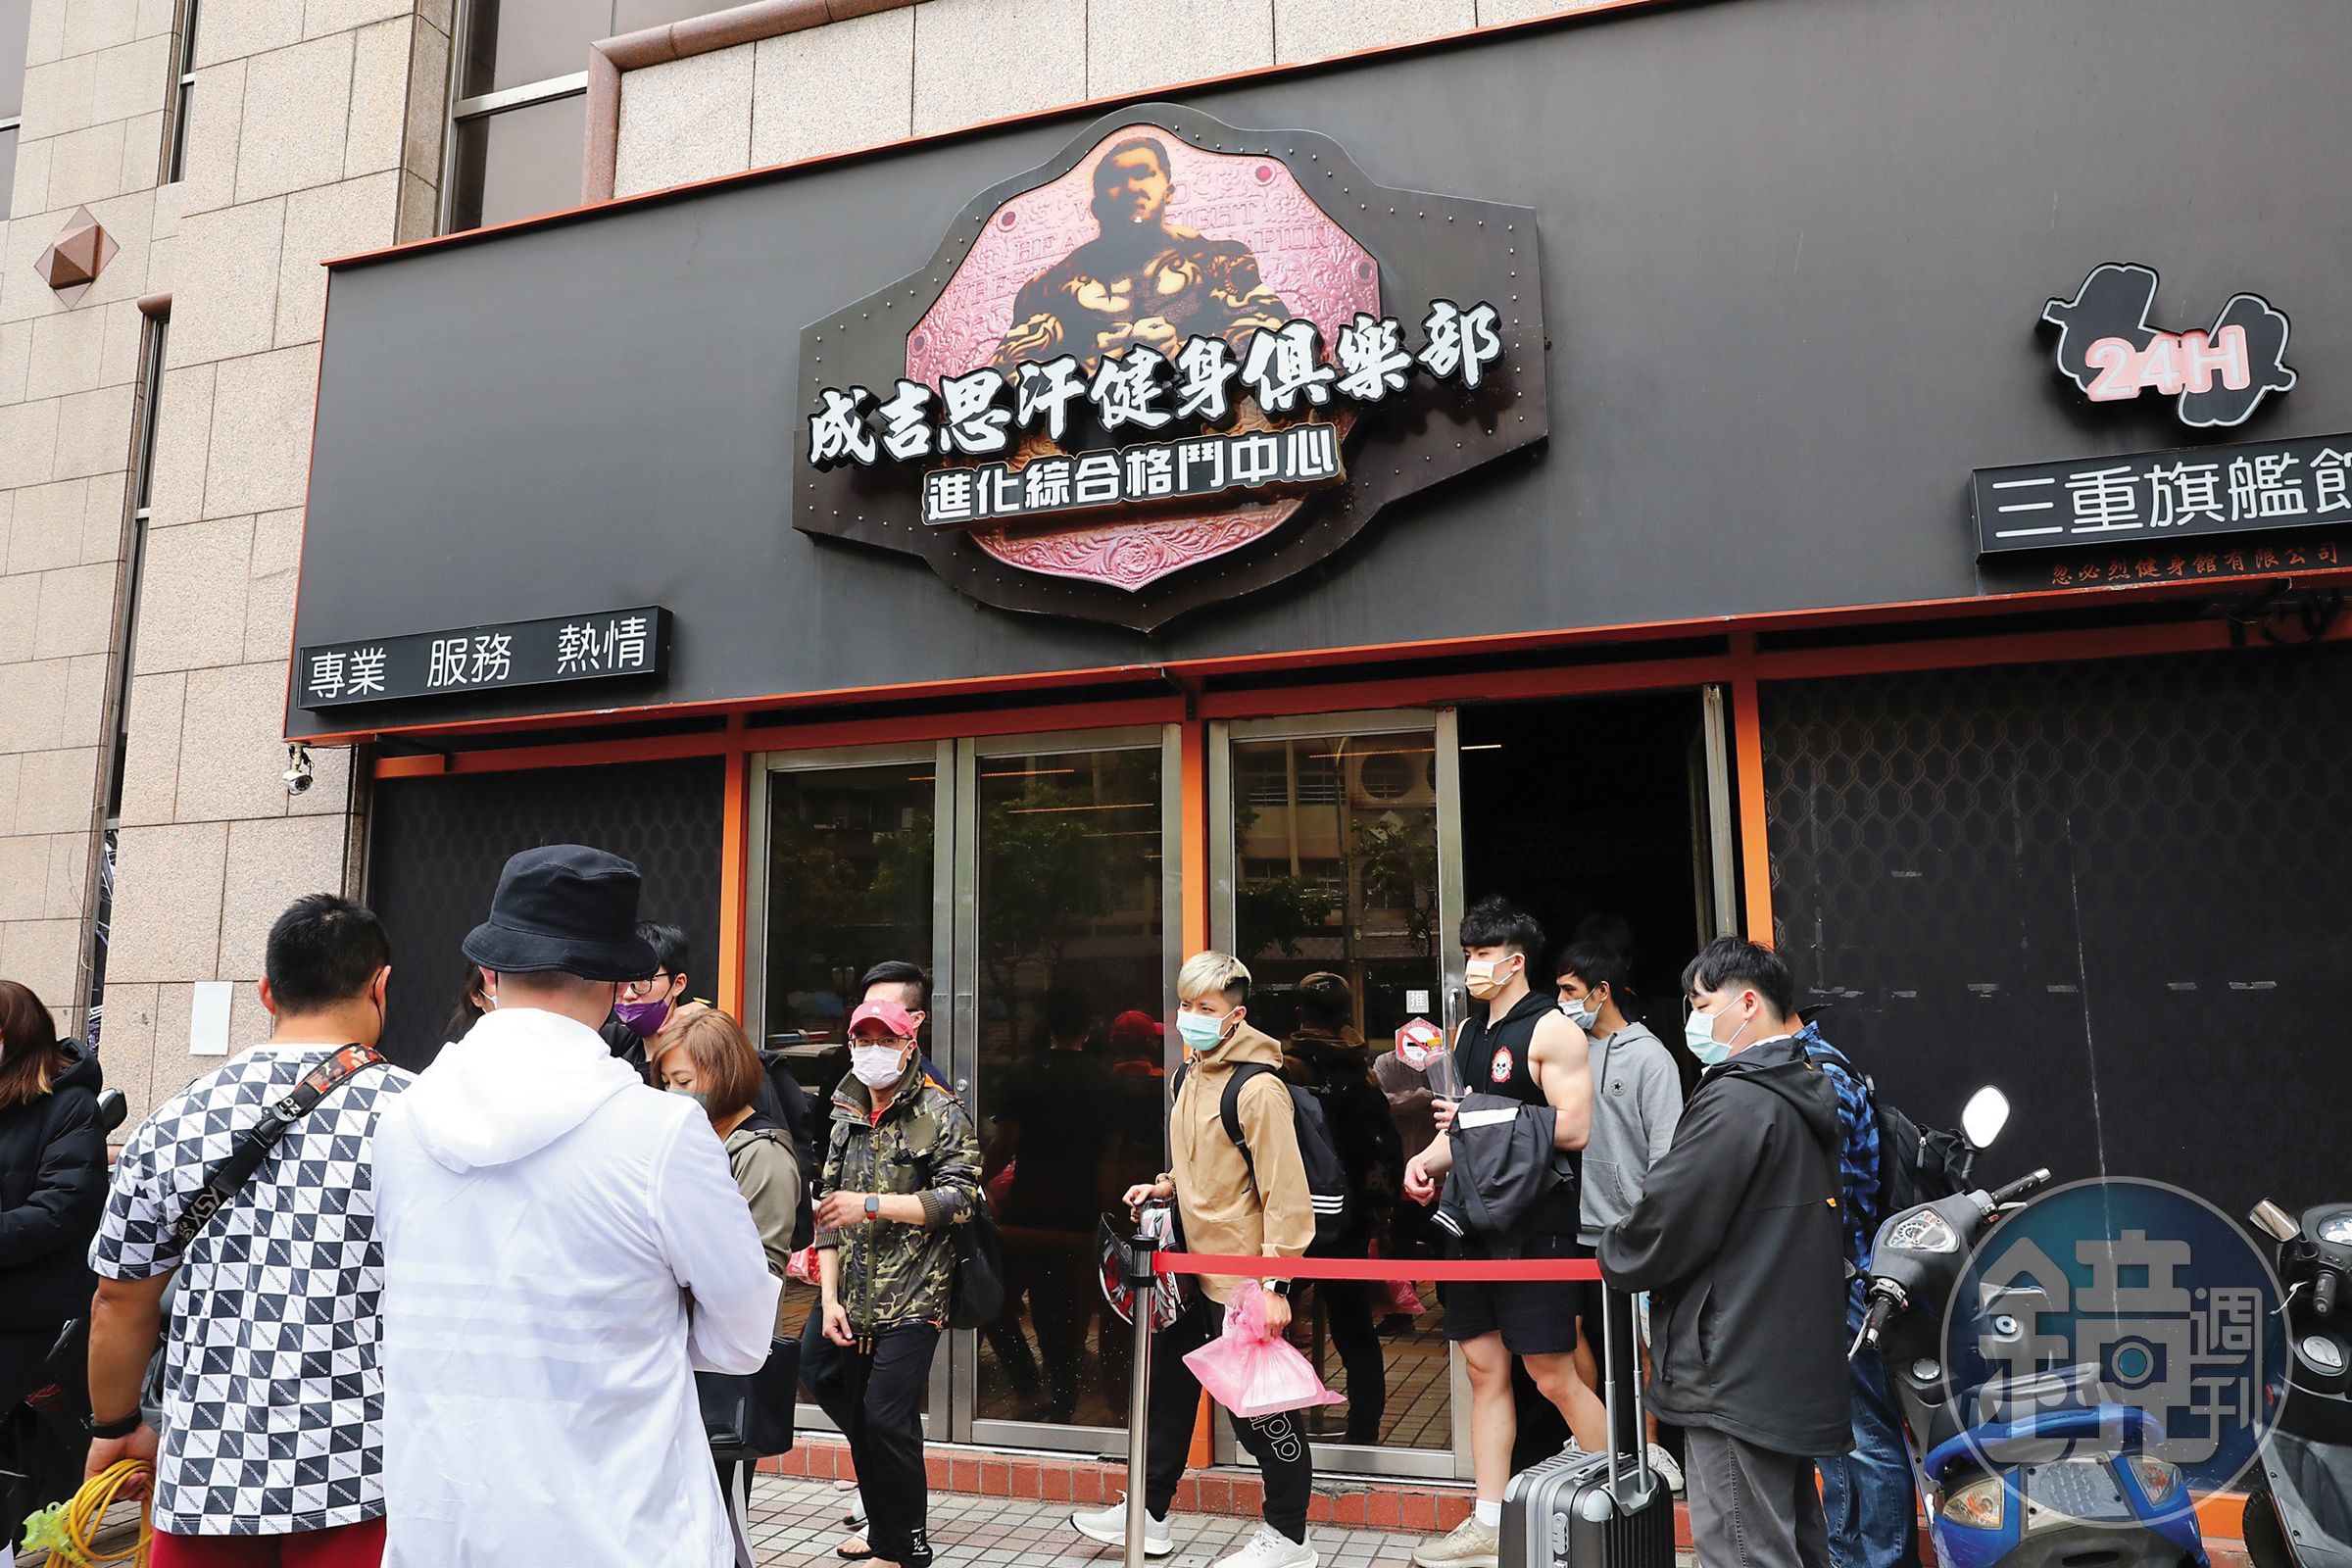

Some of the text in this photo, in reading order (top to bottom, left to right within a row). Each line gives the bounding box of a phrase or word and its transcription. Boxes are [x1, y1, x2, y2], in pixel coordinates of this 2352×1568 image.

[809, 301, 1500, 465] 成吉思汗健身俱樂部
[2085, 323, 2249, 400] 24H
[926, 429, 1335, 520] 進化綜合格鬥中心
[2052, 542, 2338, 585] 忽必烈健身館有限公司
[309, 616, 647, 699] 專業 服務 熱情
